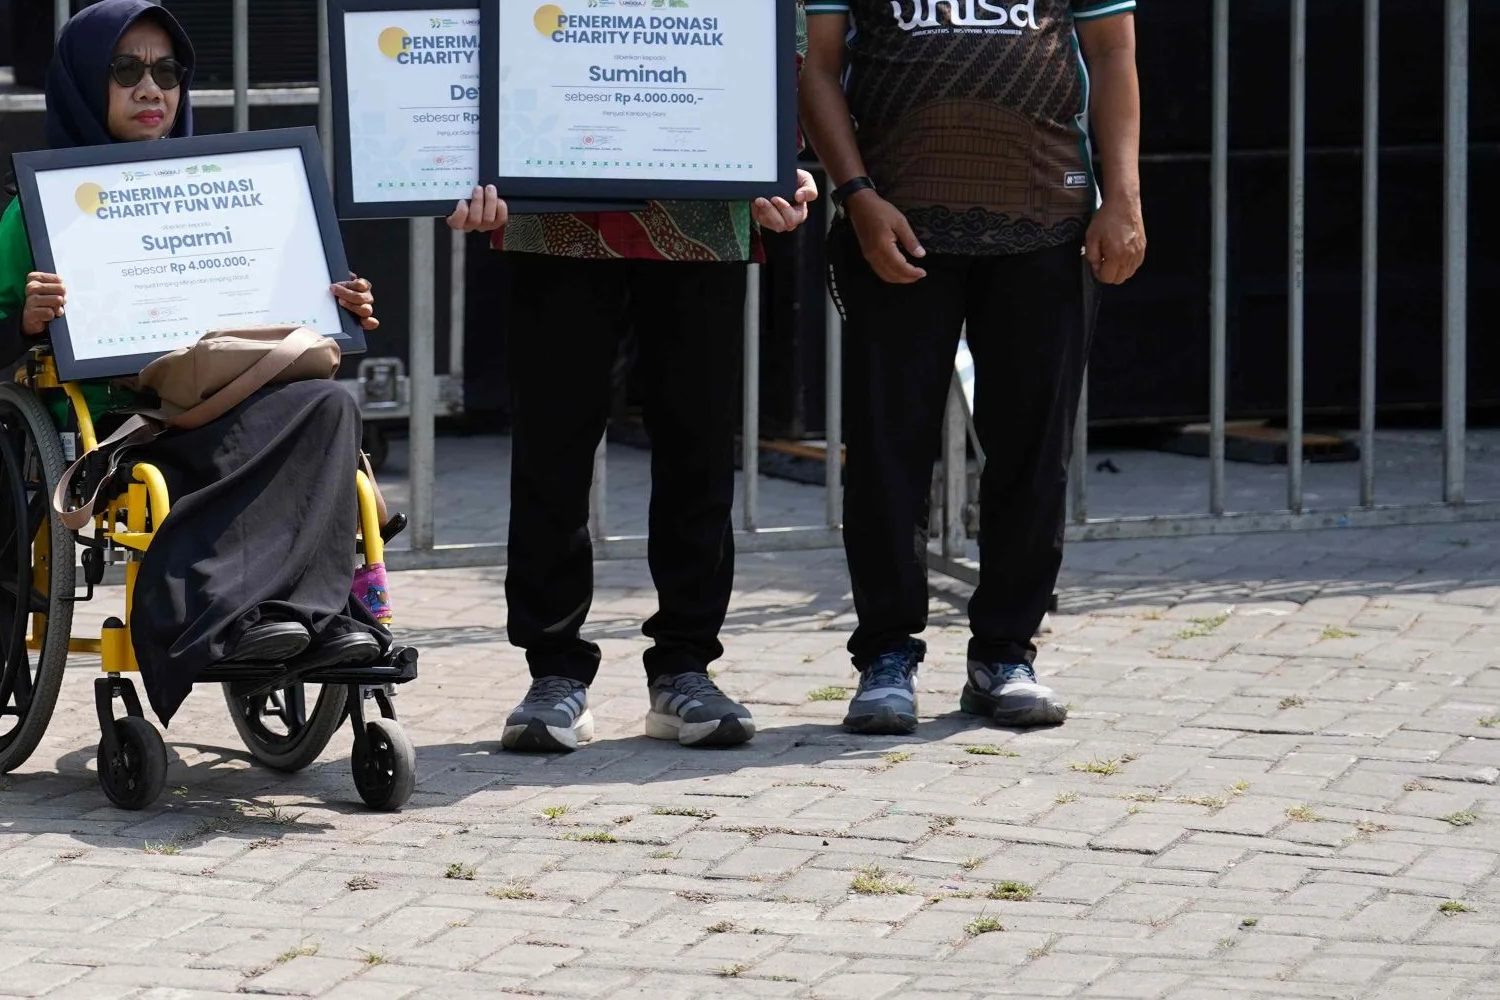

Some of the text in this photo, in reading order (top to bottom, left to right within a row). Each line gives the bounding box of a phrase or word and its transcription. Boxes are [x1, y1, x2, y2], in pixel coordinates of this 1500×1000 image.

[557, 14, 718, 31] PENERIMA DONASI
[401, 35, 480, 49] PENERIM
[551, 30, 724, 46] CHARITY FUN WALK
[396, 50, 474, 65] CHARITY
[589, 64, 687, 83] Suminah
[450, 84, 480, 101] De
[564, 91, 704, 105] sebesar Rp 4.000.000,-
[413, 112, 479, 124] sebesar Rp
[98, 178, 254, 205] PENERIMA DONASI
[96, 192, 264, 220] CHARITY FUN WALK
[141, 225, 233, 254] Suparmi
[121, 256, 256, 278] sebesar Rp 4.000.000,-
